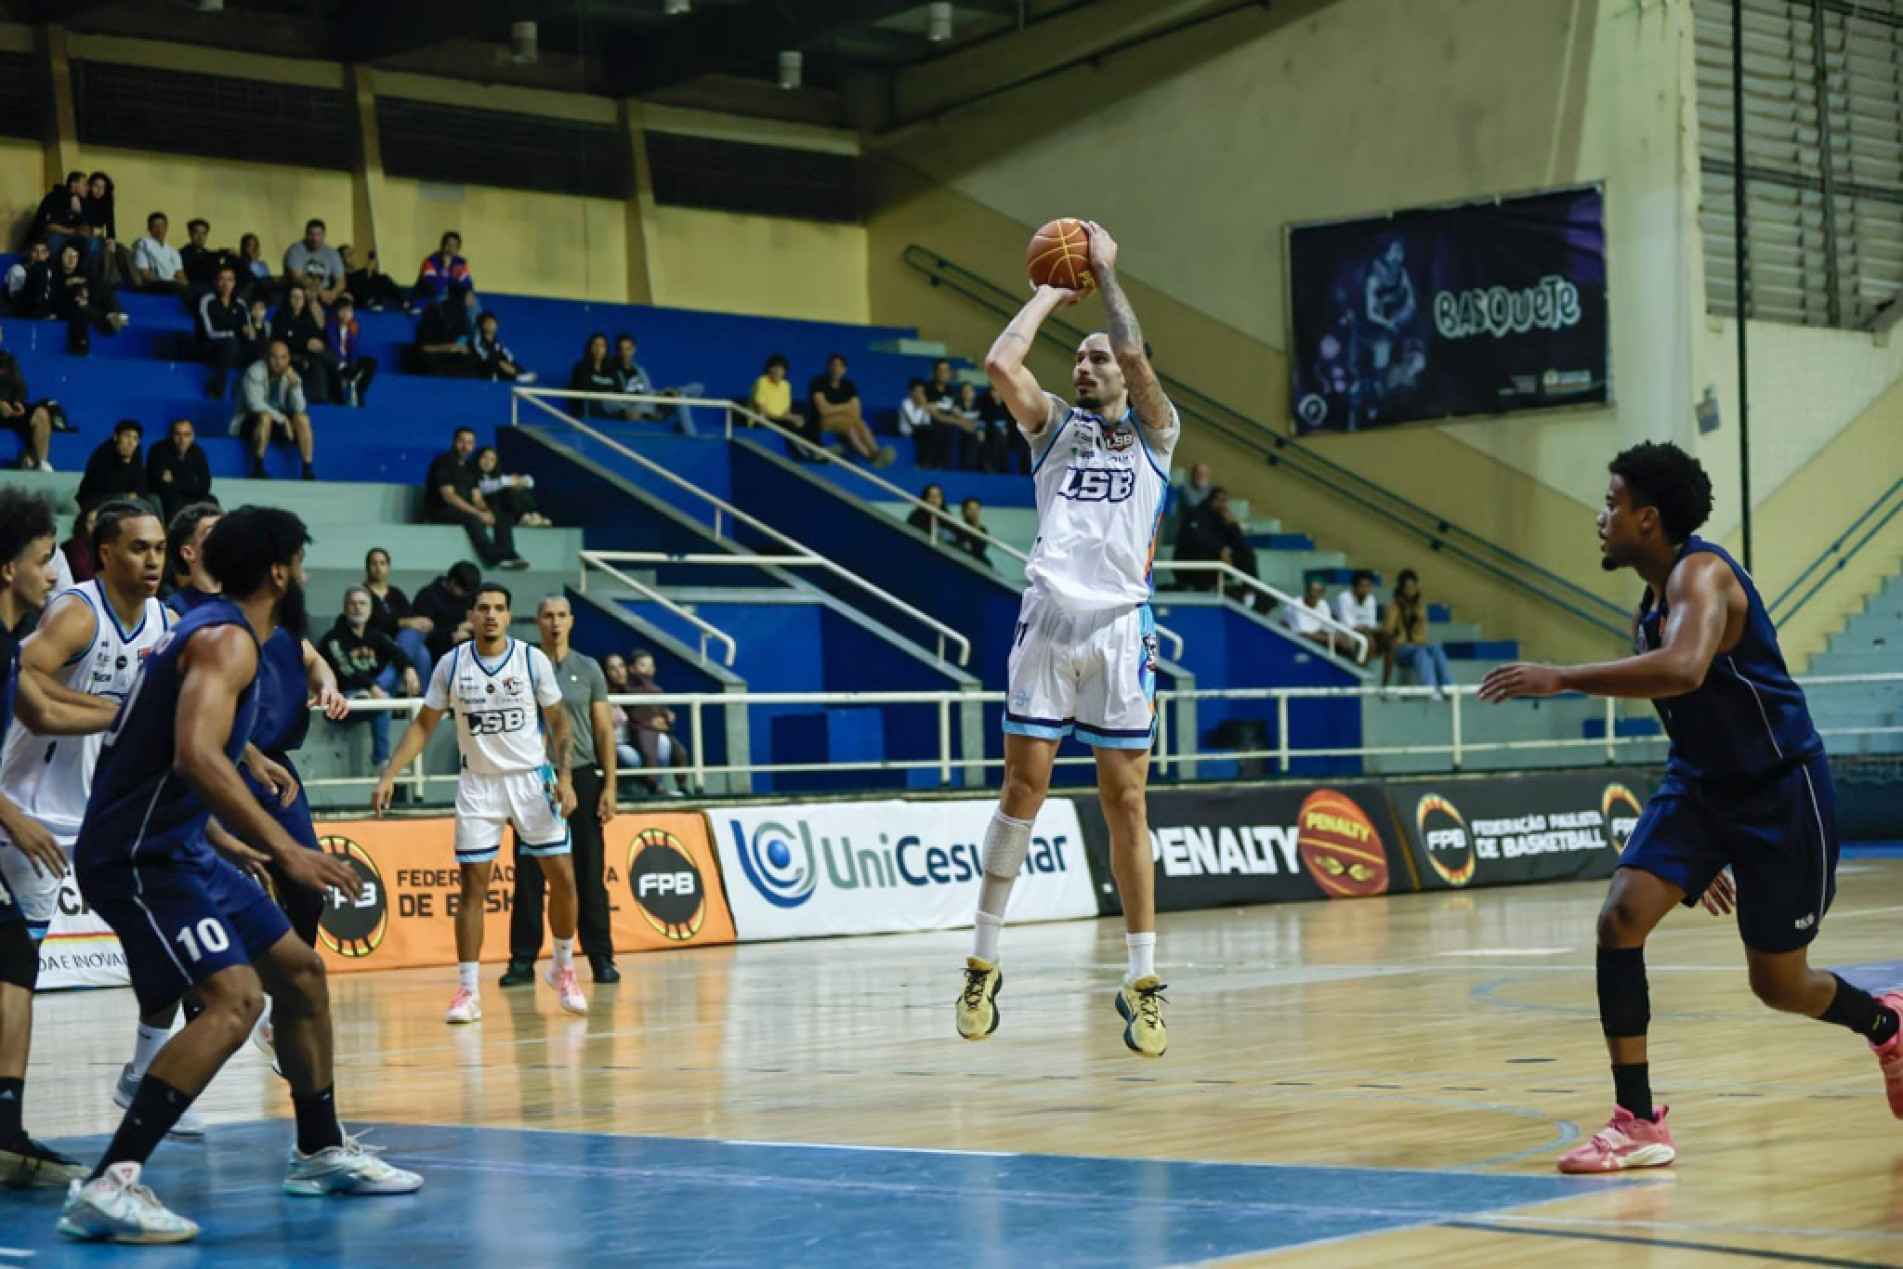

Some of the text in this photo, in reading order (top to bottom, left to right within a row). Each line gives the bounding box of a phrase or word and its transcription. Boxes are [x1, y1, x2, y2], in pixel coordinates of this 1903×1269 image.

[1057, 466, 1135, 502] LSB
[1306, 812, 1371, 843] PENALTY
[1427, 828, 1466, 850] FPB
[1472, 813, 1546, 836] FEDERAÇÃO
[1475, 828, 1607, 859] DE BASKETBALL
[821, 832, 1067, 889] UniCesar
[638, 871, 695, 898] FPB
[400, 894, 433, 917] DE
[176, 917, 230, 962] 10
